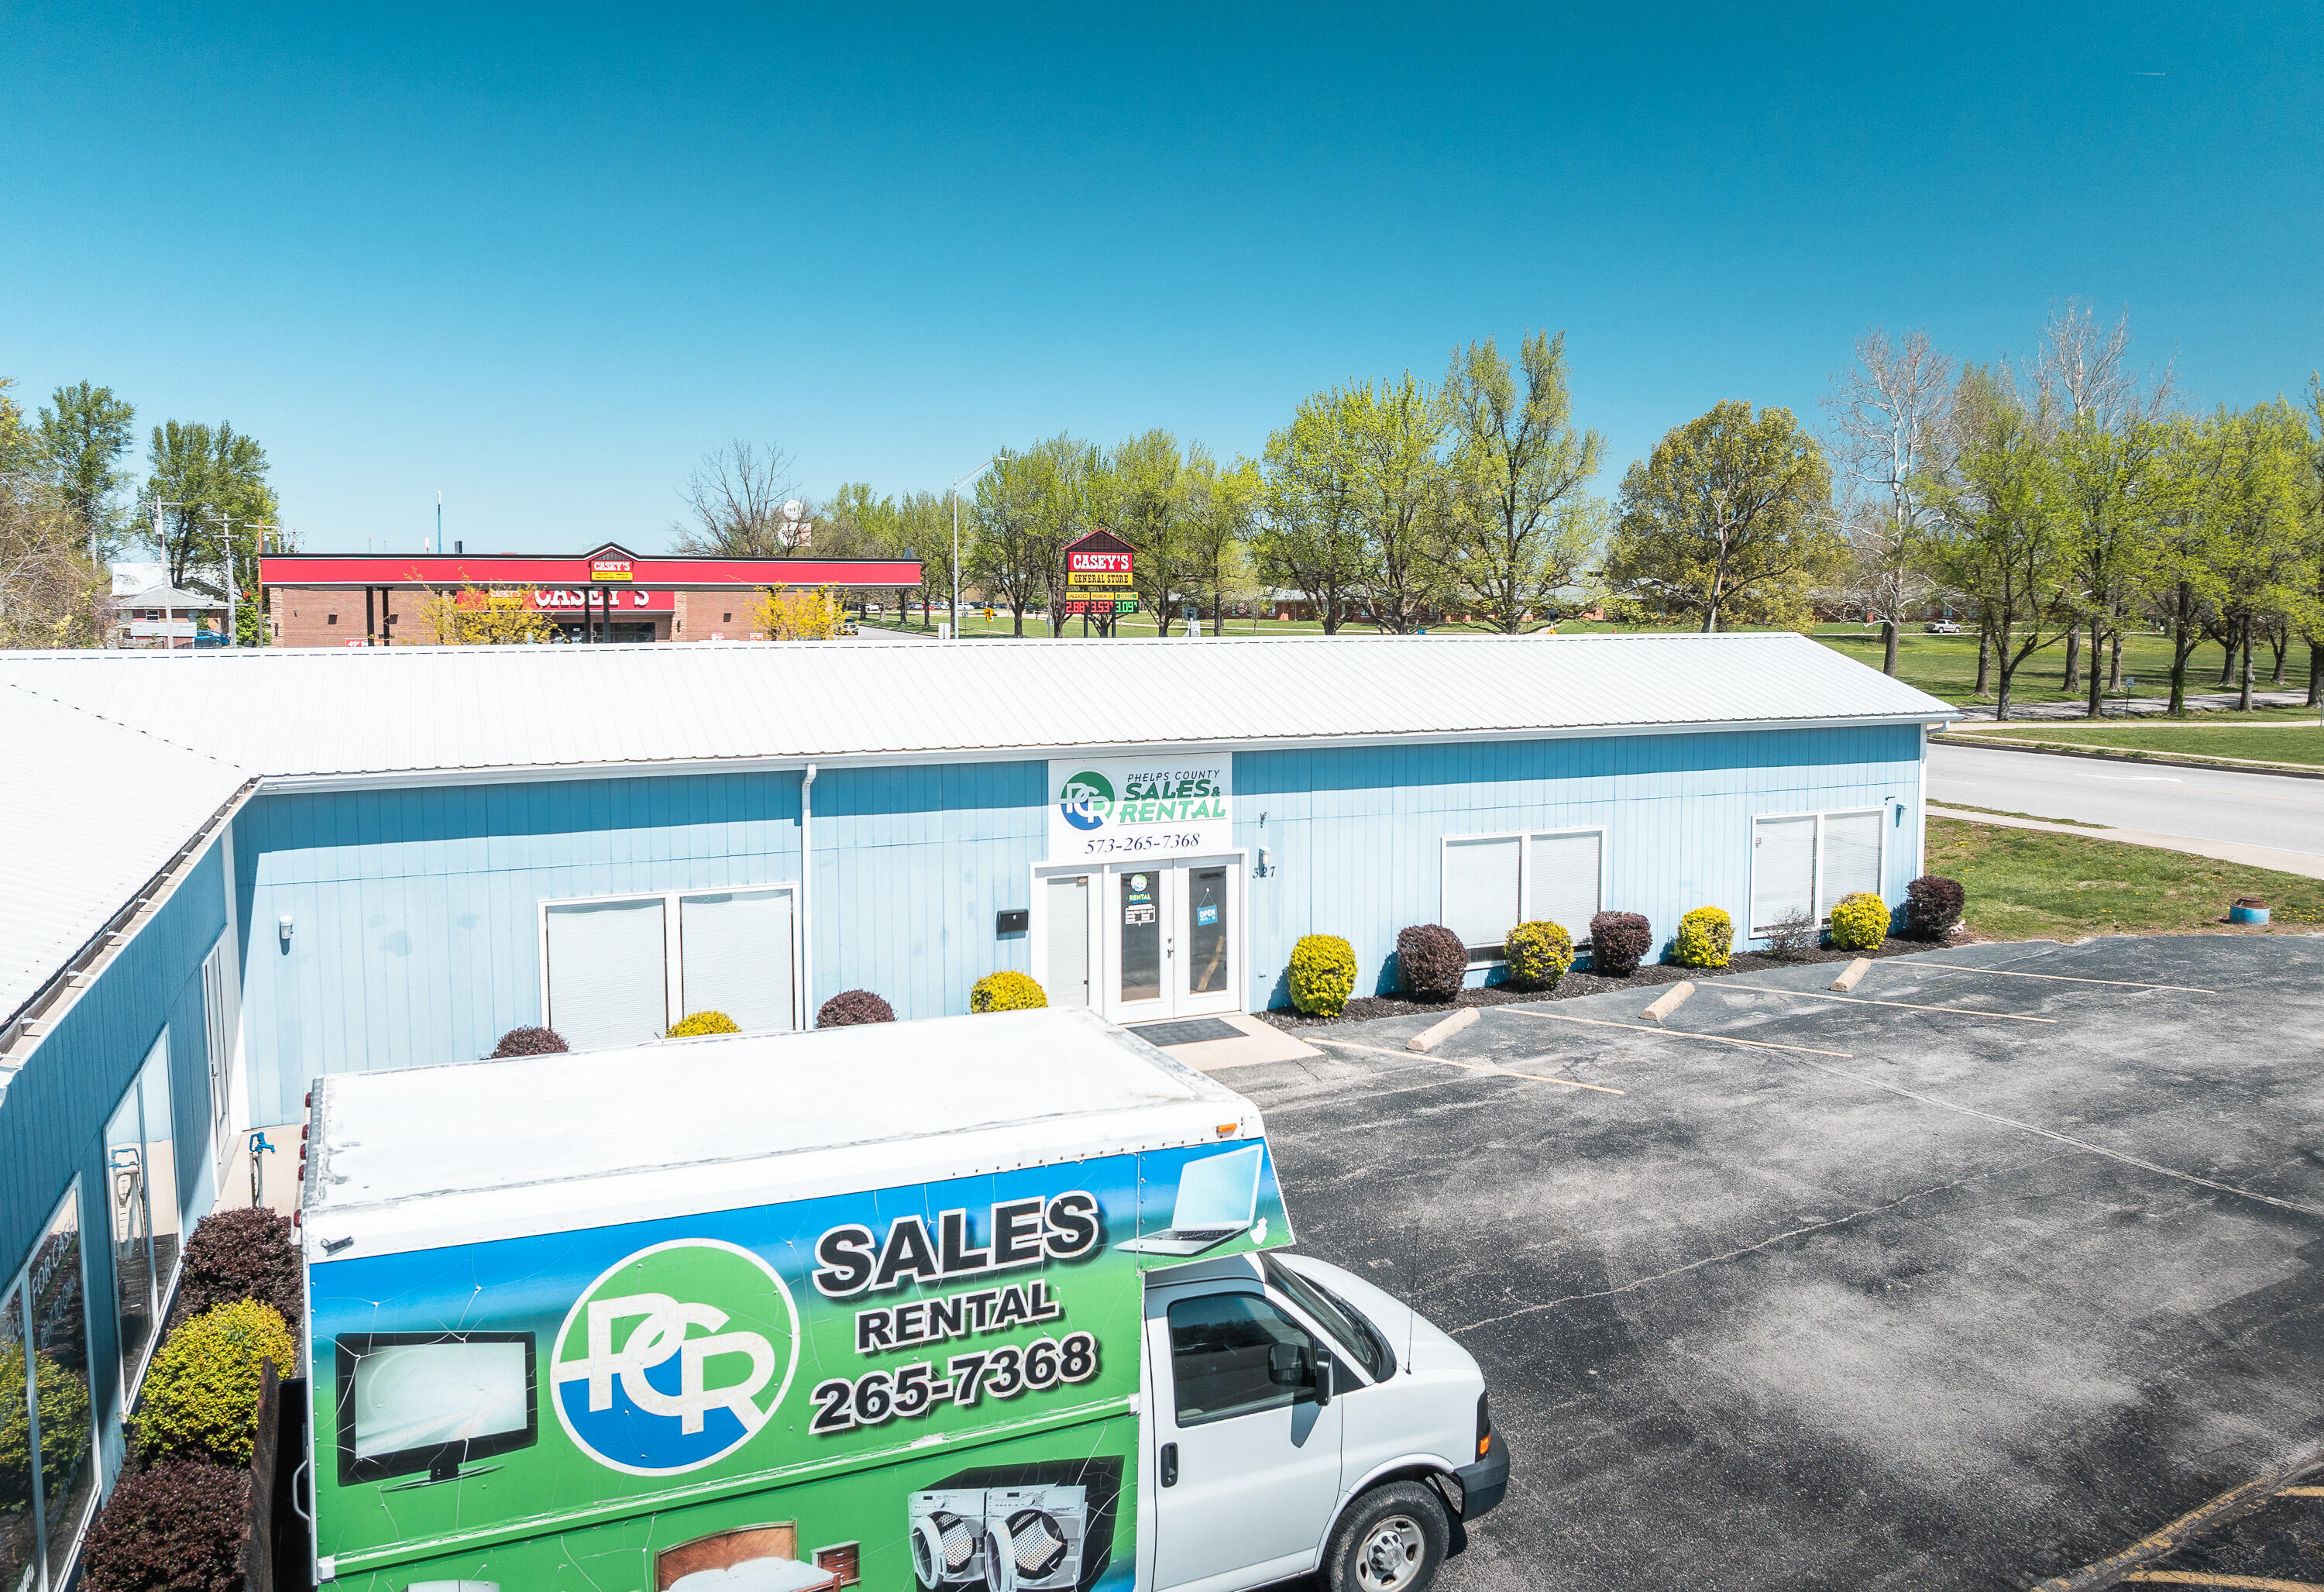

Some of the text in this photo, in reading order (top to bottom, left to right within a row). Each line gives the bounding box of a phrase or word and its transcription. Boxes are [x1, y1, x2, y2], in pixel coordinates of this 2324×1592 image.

[593, 562, 631, 571] CASEY'S
[1073, 554, 1129, 570] CASEY'S
[1074, 574, 1129, 583] GENERAL STORE
[1127, 769, 1221, 782] PHELPS COUNTY
[1119, 798, 1226, 824] RENTAL
[1085, 832, 1200, 854] 573-265-7368
[1252, 865, 1276, 879] 327
[1199, 908, 1216, 918] OPEN
[812, 1189, 1100, 1297] SALES
[32, 1255, 52, 1306] FOR
[854, 1278, 1061, 1355] RENTAL
[808, 1330, 1097, 1436] 265-7368
